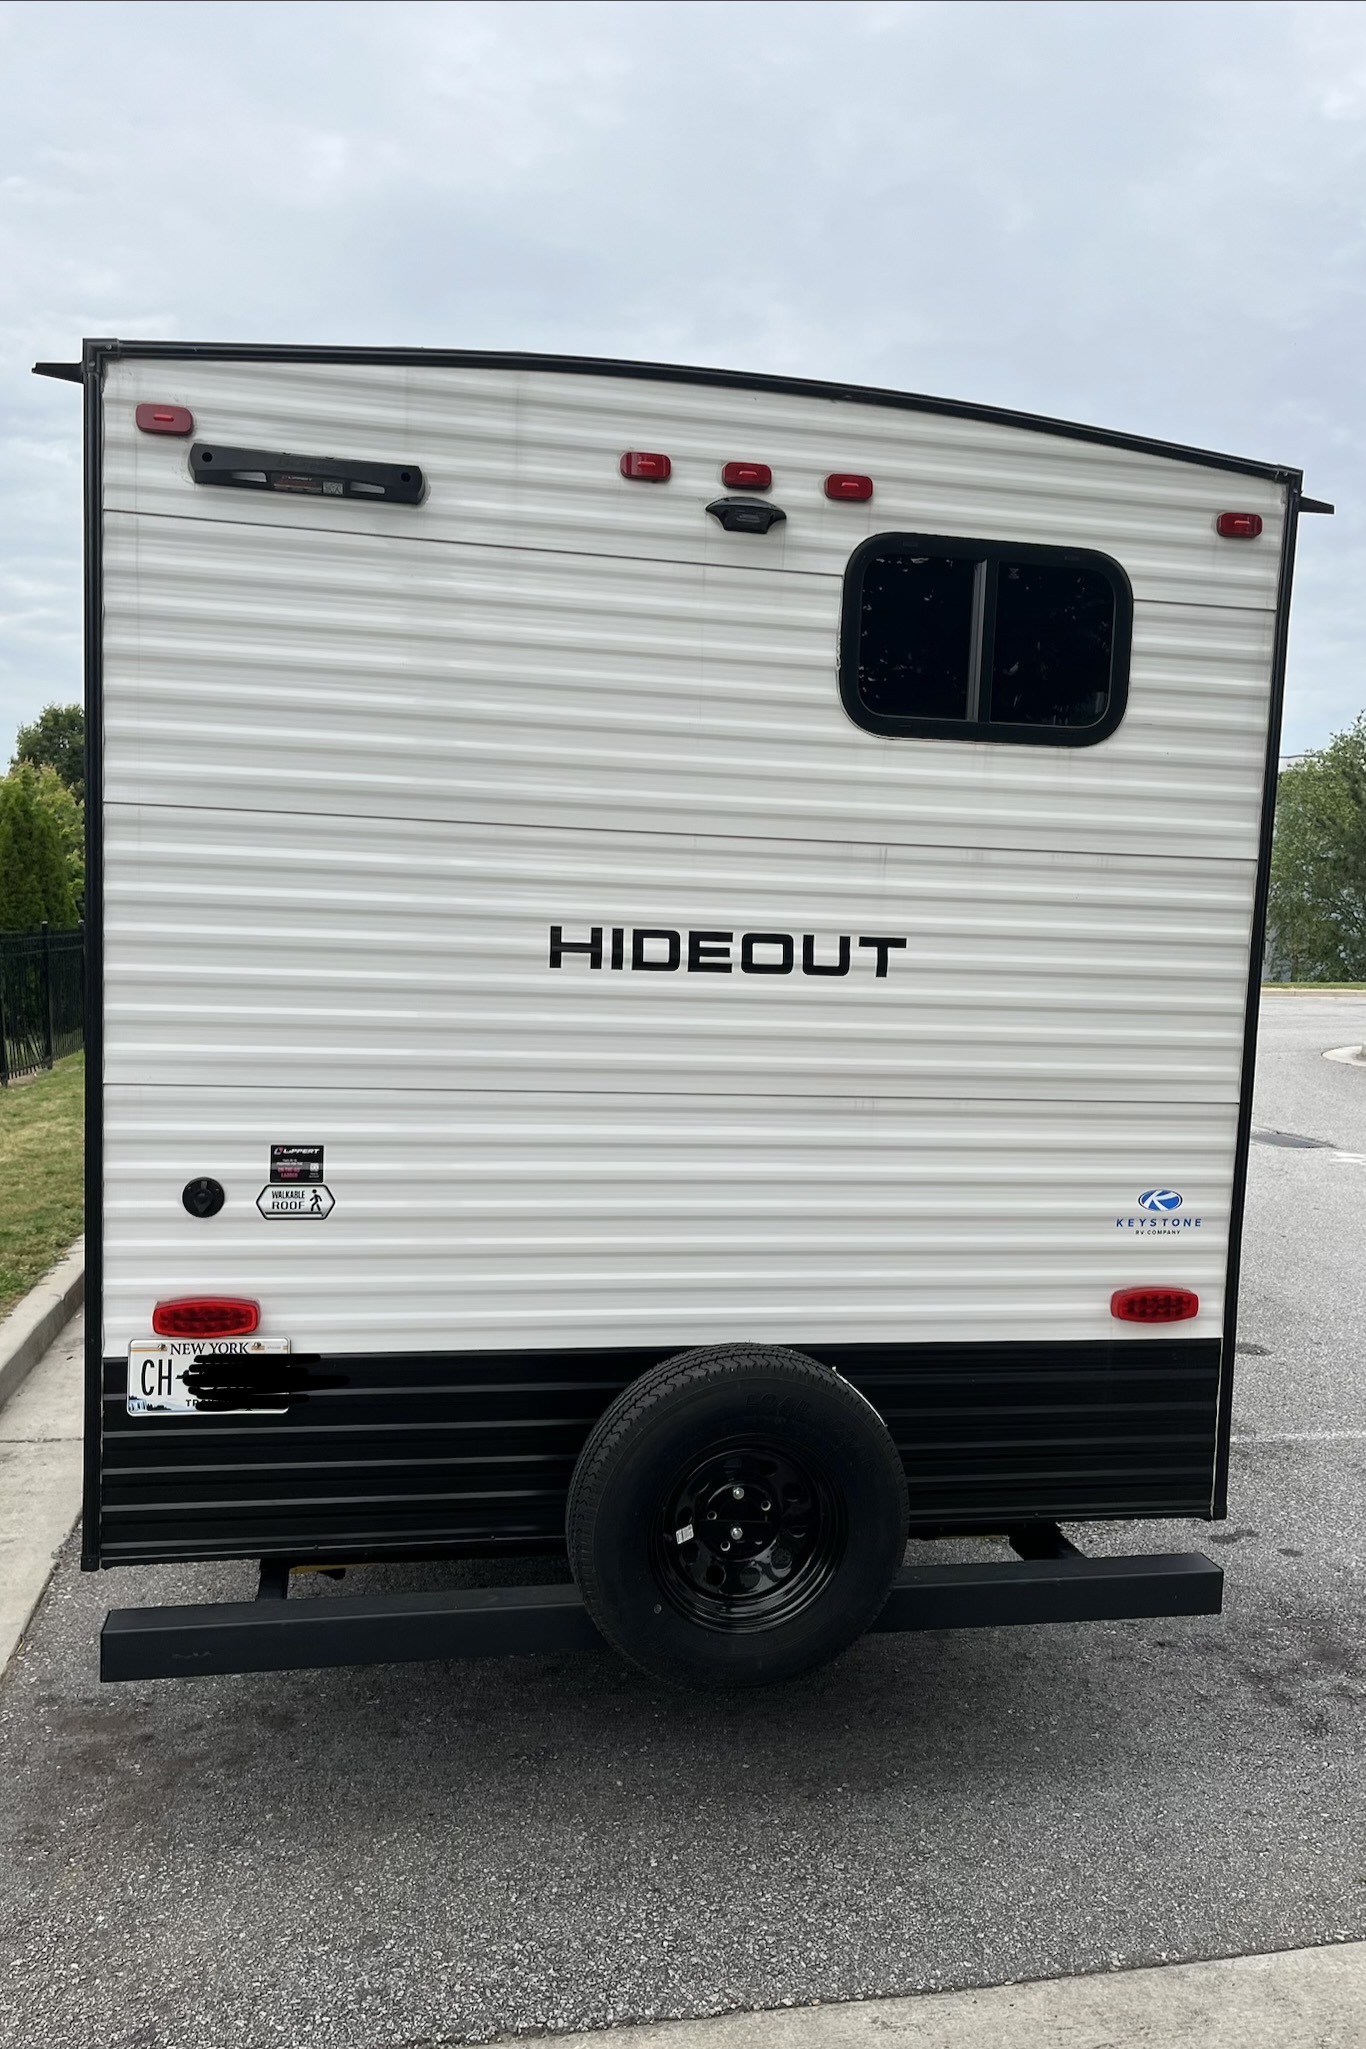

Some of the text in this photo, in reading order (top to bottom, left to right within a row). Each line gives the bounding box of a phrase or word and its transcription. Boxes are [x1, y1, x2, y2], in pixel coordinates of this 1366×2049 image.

[549, 926, 907, 977] HIDEOUT
[272, 1190, 305, 1199] WALKABLE
[272, 1201, 305, 1210] ROOF
[1116, 1218, 1202, 1227] KEYSTONE
[170, 1342, 249, 1355] NEW YORK
